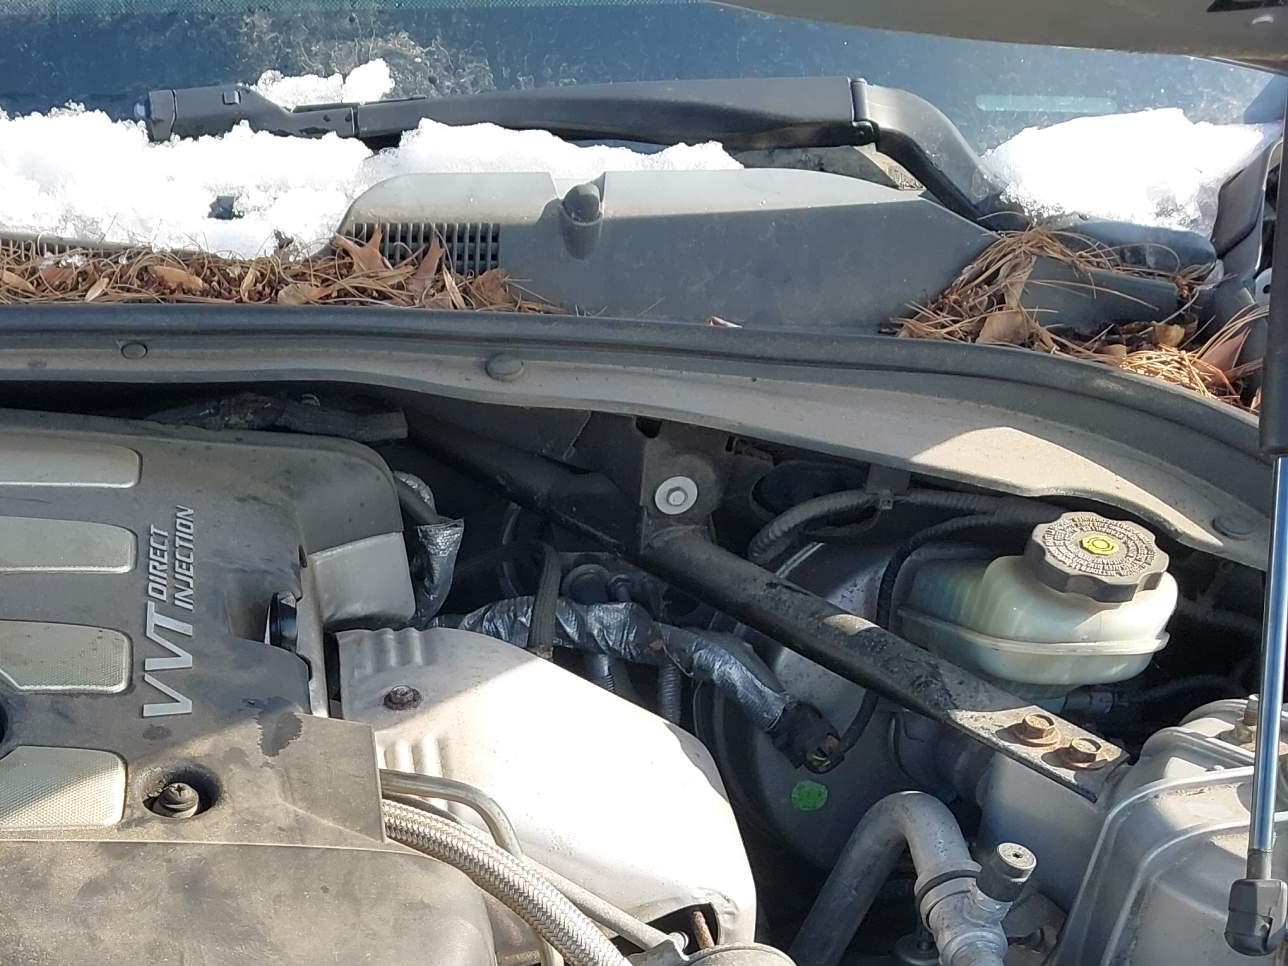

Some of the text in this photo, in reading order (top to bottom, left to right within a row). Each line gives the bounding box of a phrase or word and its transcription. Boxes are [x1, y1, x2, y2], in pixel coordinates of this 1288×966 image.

[148, 524, 169, 601] DIRECT
[174, 504, 195, 610] INJECTION
[143, 600, 193, 718] VVT
